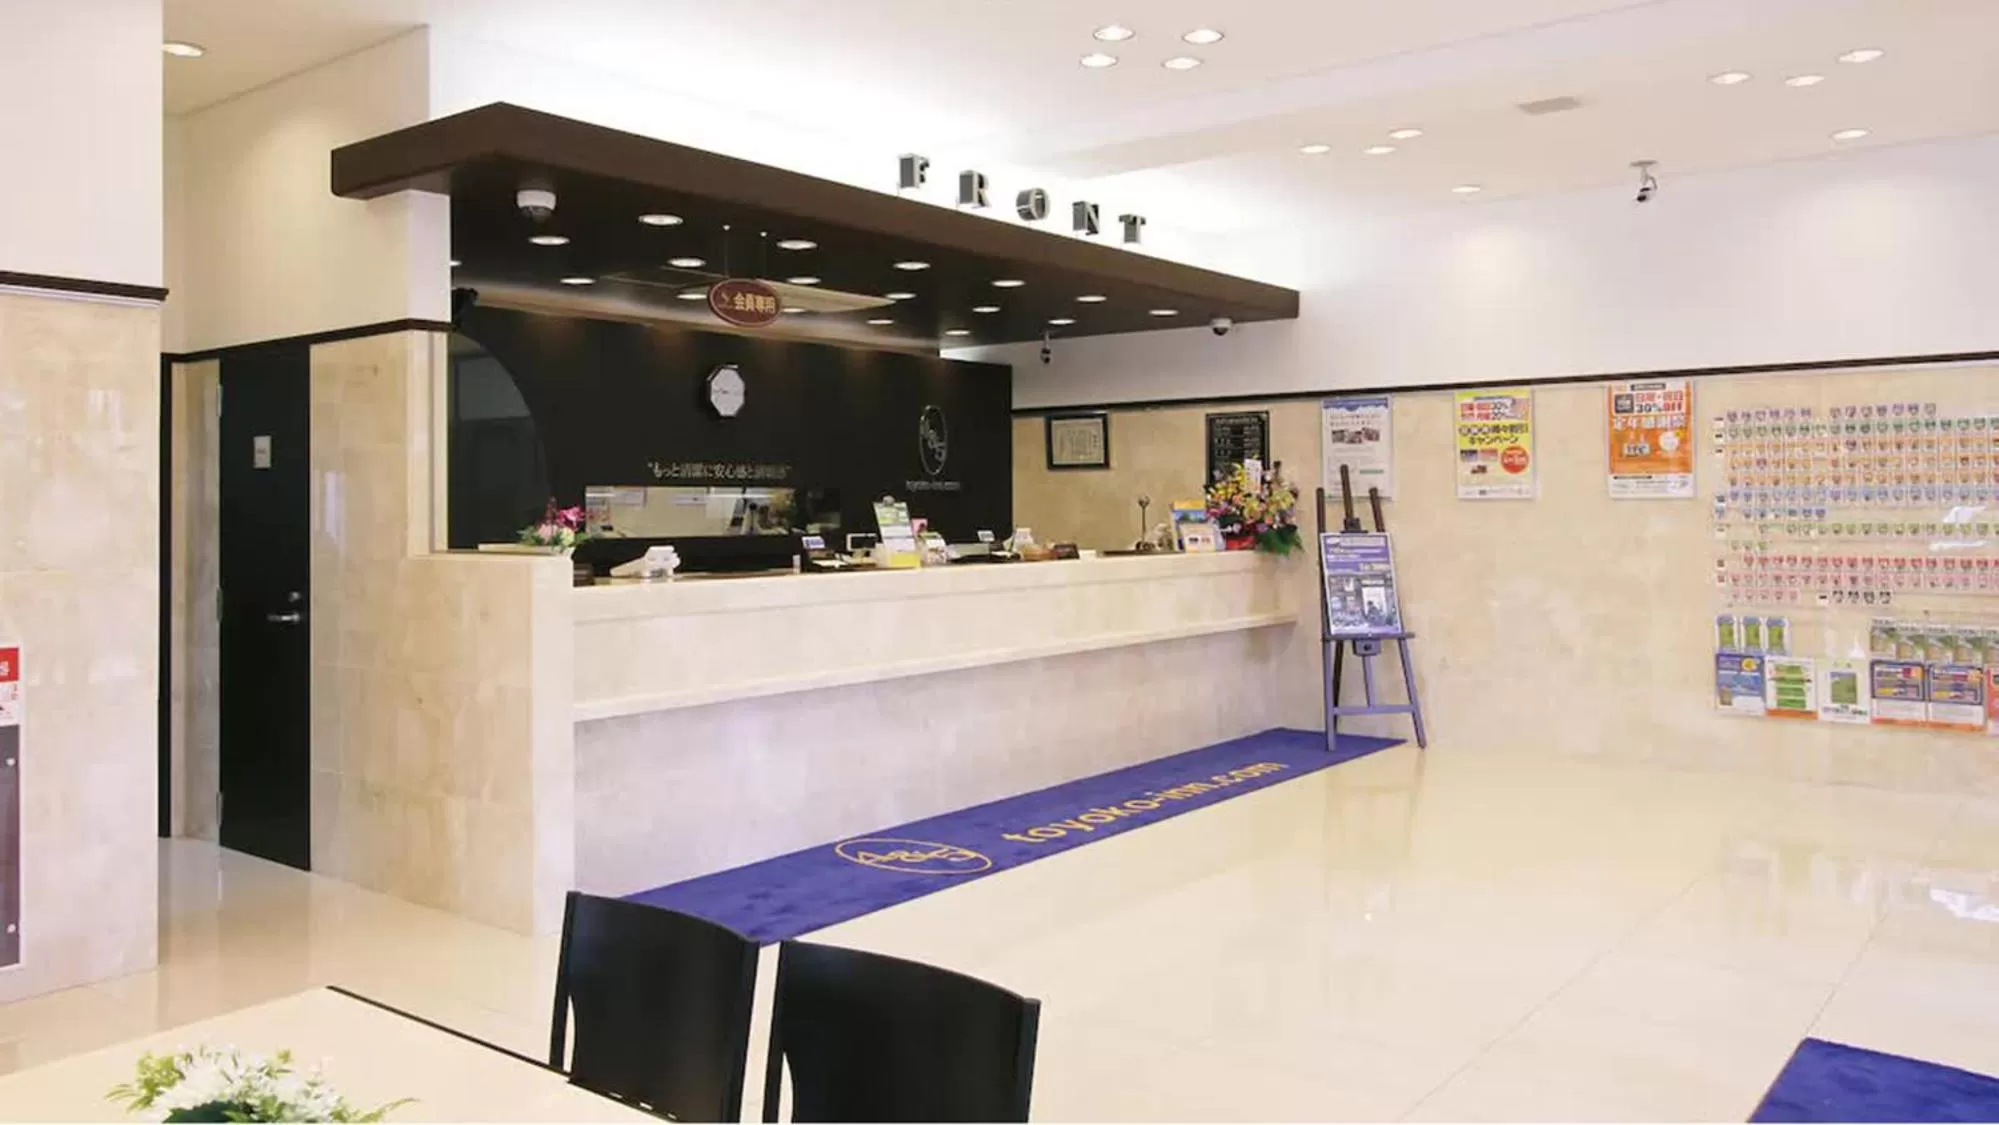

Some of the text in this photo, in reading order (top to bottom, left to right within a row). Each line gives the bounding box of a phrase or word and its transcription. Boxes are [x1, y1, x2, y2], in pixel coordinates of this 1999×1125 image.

[899, 153, 1147, 245] FRONT
[733, 291, 776, 314] 会員専用
[1003, 761, 1288, 844] toyoko-inn.com
